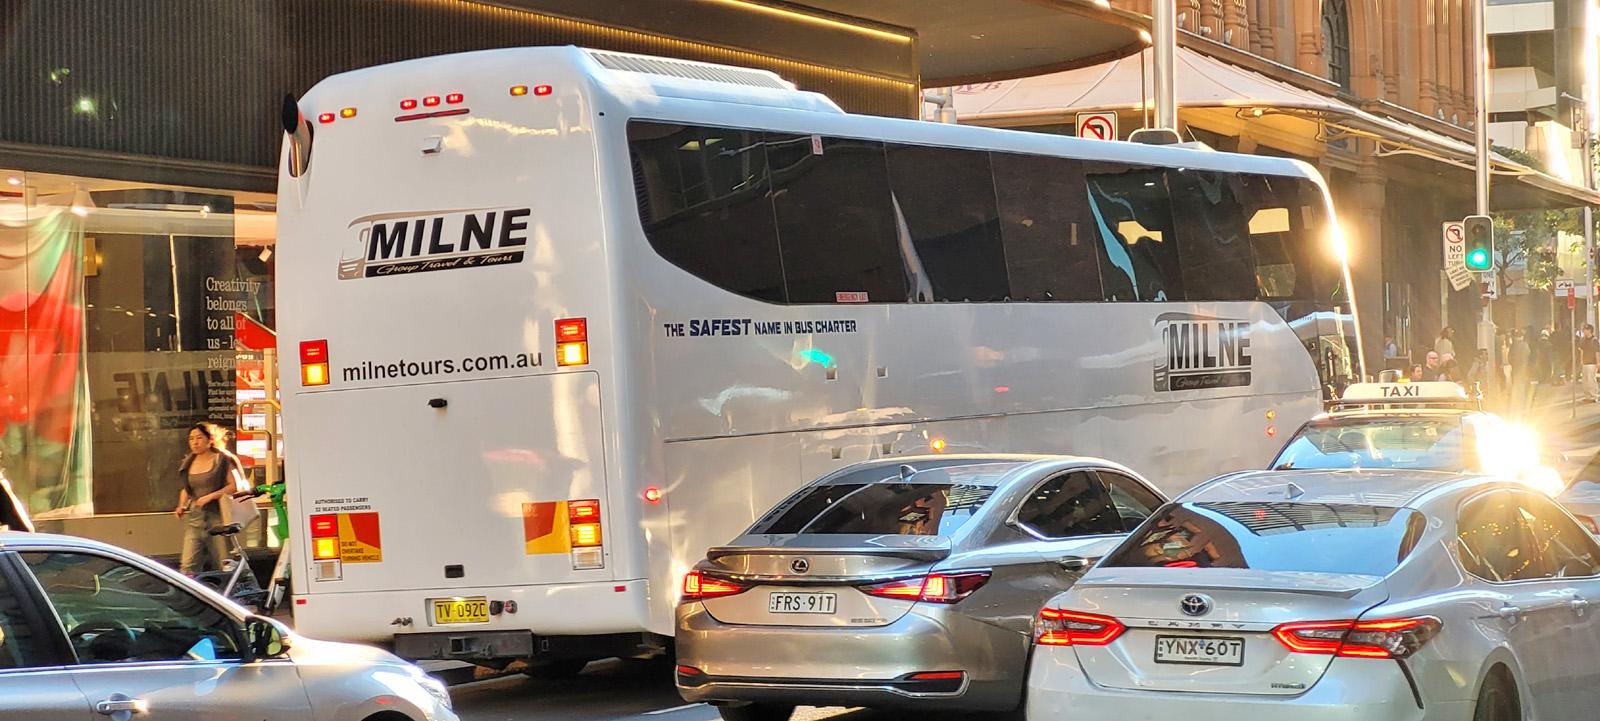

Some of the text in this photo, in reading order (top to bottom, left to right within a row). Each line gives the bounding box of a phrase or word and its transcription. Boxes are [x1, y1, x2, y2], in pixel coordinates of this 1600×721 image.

[367, 208, 531, 261] MILNE
[1449, 245, 1462, 253] NO
[376, 254, 513, 275] Group Travel & Tours
[206, 276, 261, 294] Creativity
[206, 296, 248, 313] belongs
[207, 316, 218, 330] to
[220, 316, 234, 330] all
[664, 318, 857, 337] THE SAFEST NAME IN BUS CHARTER
[207, 338, 220, 349] us
[1169, 322, 1252, 370] MILNE
[342, 352, 543, 381] milnetours.com.au
[1380, 386, 1419, 397] TAXI
